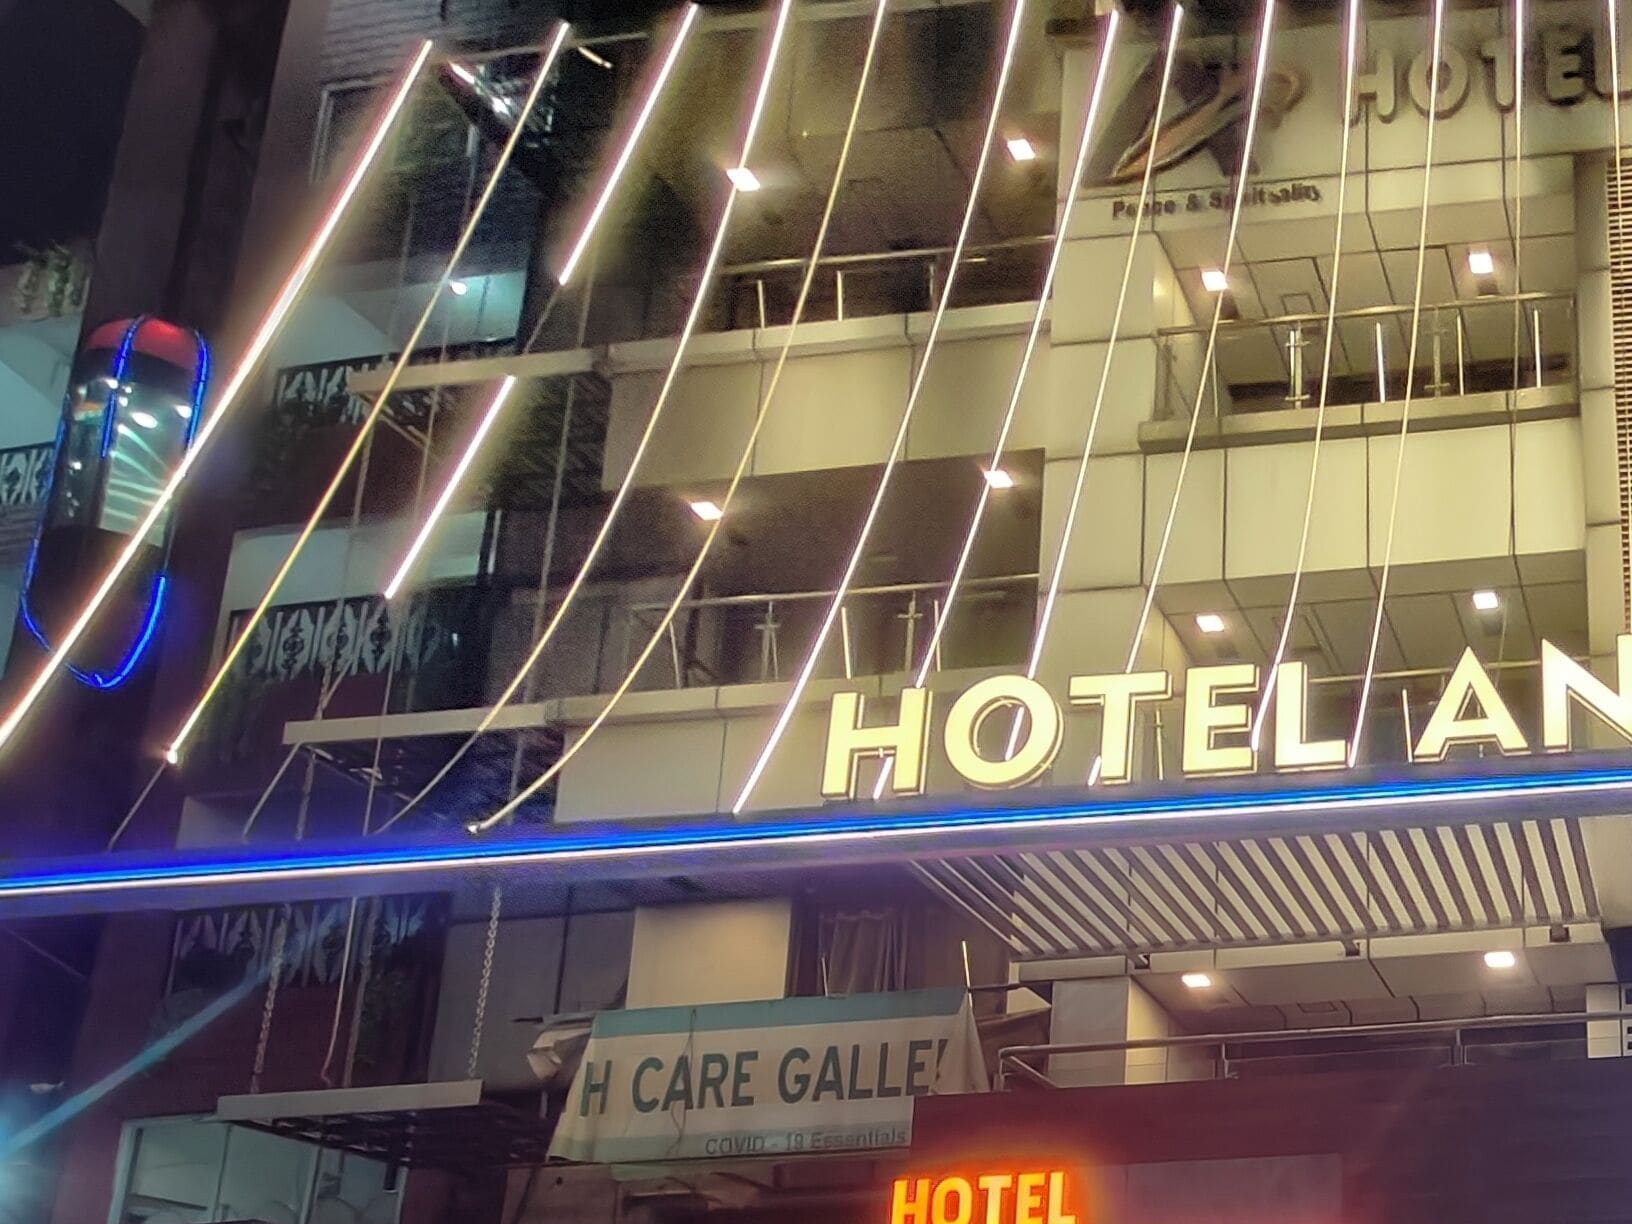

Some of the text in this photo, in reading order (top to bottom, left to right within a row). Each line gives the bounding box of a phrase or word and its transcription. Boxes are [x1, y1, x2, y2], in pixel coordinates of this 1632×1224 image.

[820, 661, 1347, 799] HOTEL
[632, 1050, 760, 1113] CARE
[705, 1134, 765, 1155] COVID
[810, 1127, 906, 1149] Essentials
